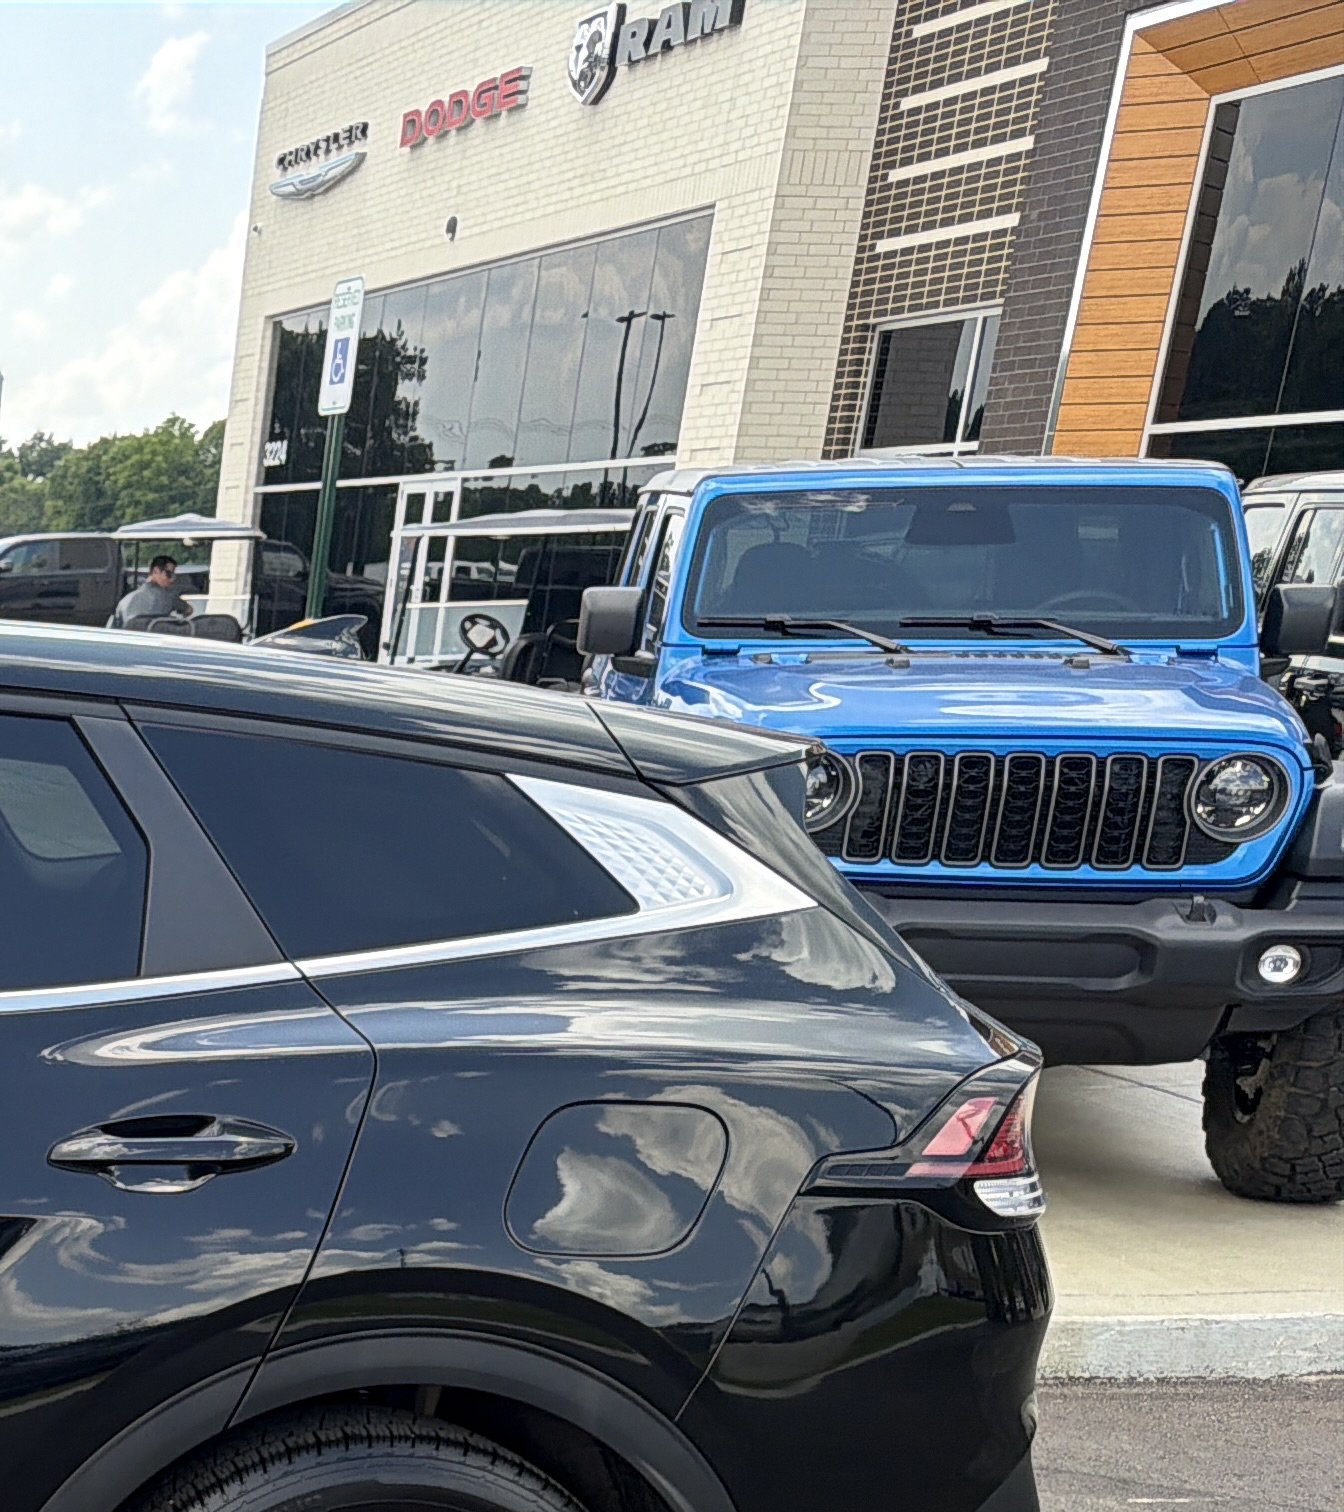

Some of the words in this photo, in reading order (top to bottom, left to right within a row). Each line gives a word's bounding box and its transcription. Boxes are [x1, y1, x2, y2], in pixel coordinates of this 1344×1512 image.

[615, 0, 746, 67] RAM
[399, 66, 532, 150] DODGE
[275, 120, 370, 173] CHRYSLER
